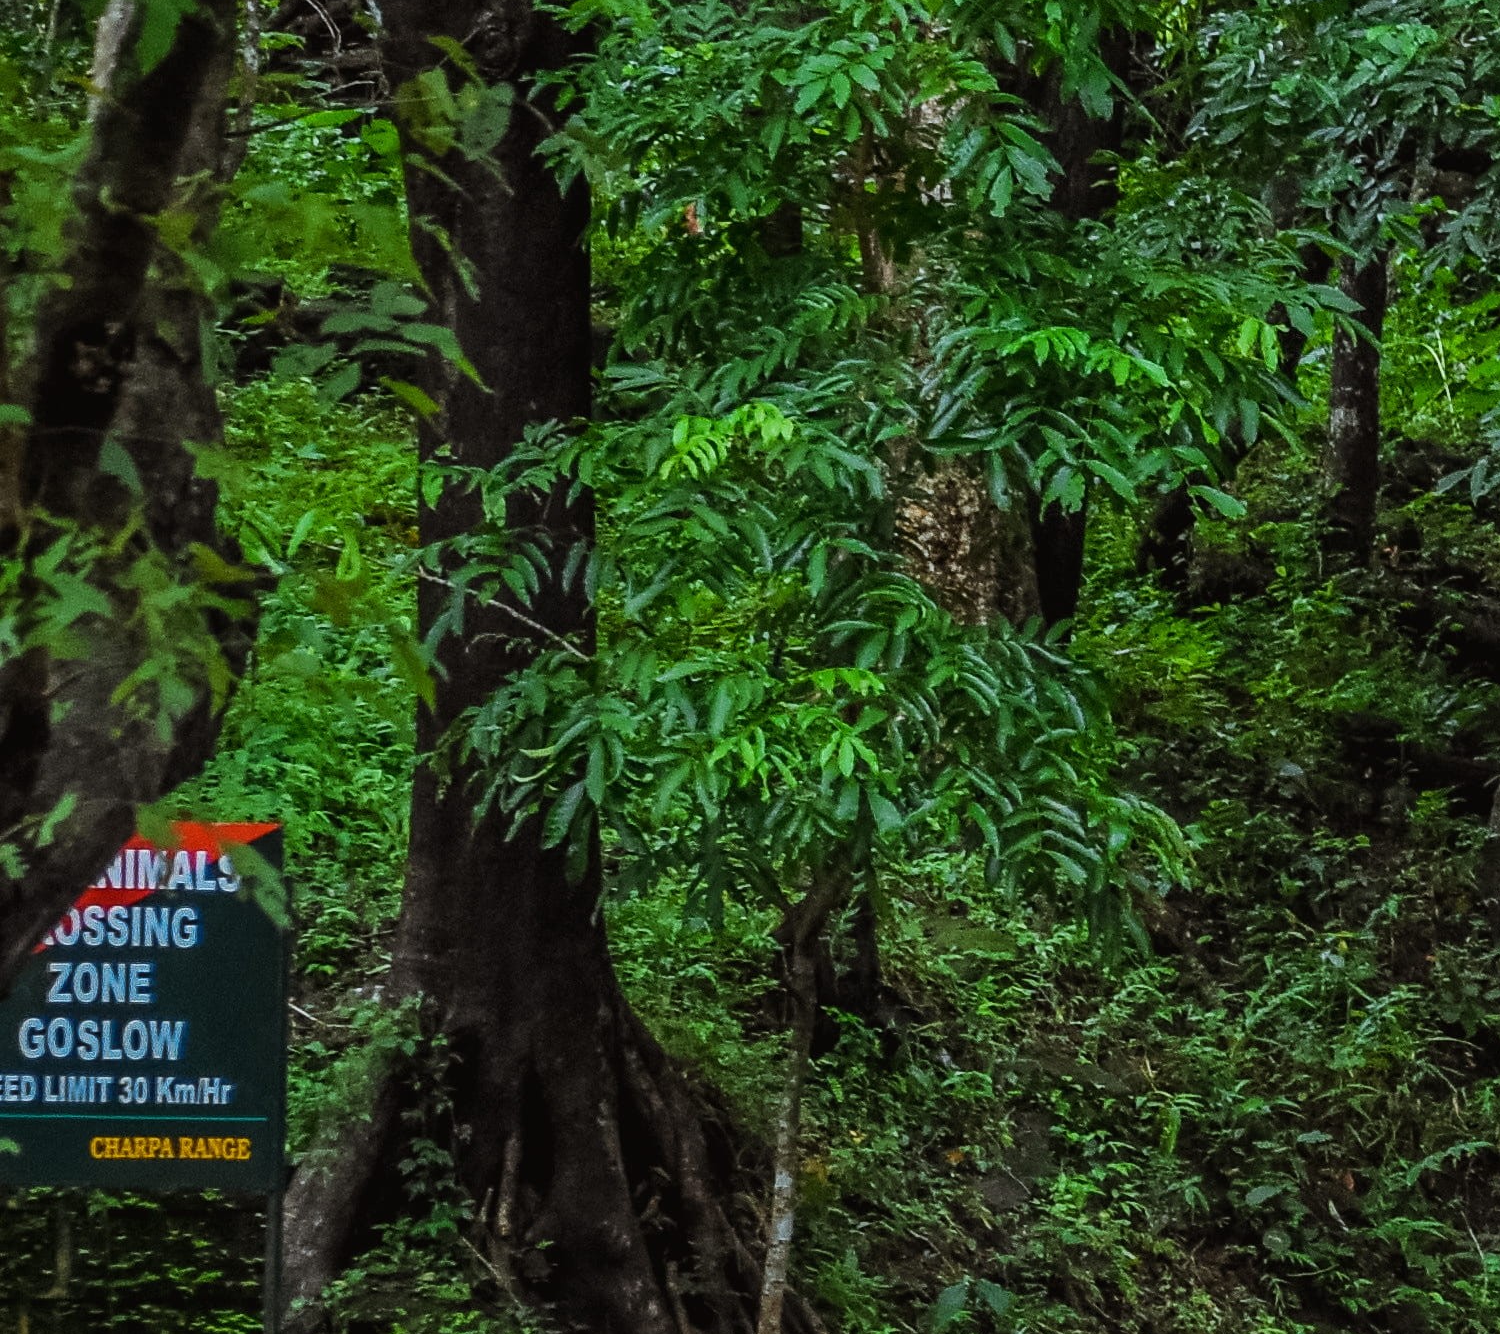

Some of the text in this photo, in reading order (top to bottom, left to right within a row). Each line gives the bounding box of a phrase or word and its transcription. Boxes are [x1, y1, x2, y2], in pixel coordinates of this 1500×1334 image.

[88, 848, 241, 892] NIMALS
[47, 962, 154, 1004] ZONE
[43, 1075, 114, 1103] LIMIT
[118, 1076, 149, 1105] 30
[155, 1076, 234, 1105] Km/Hr
[89, 1136, 252, 1161] CHARPA RANGE
